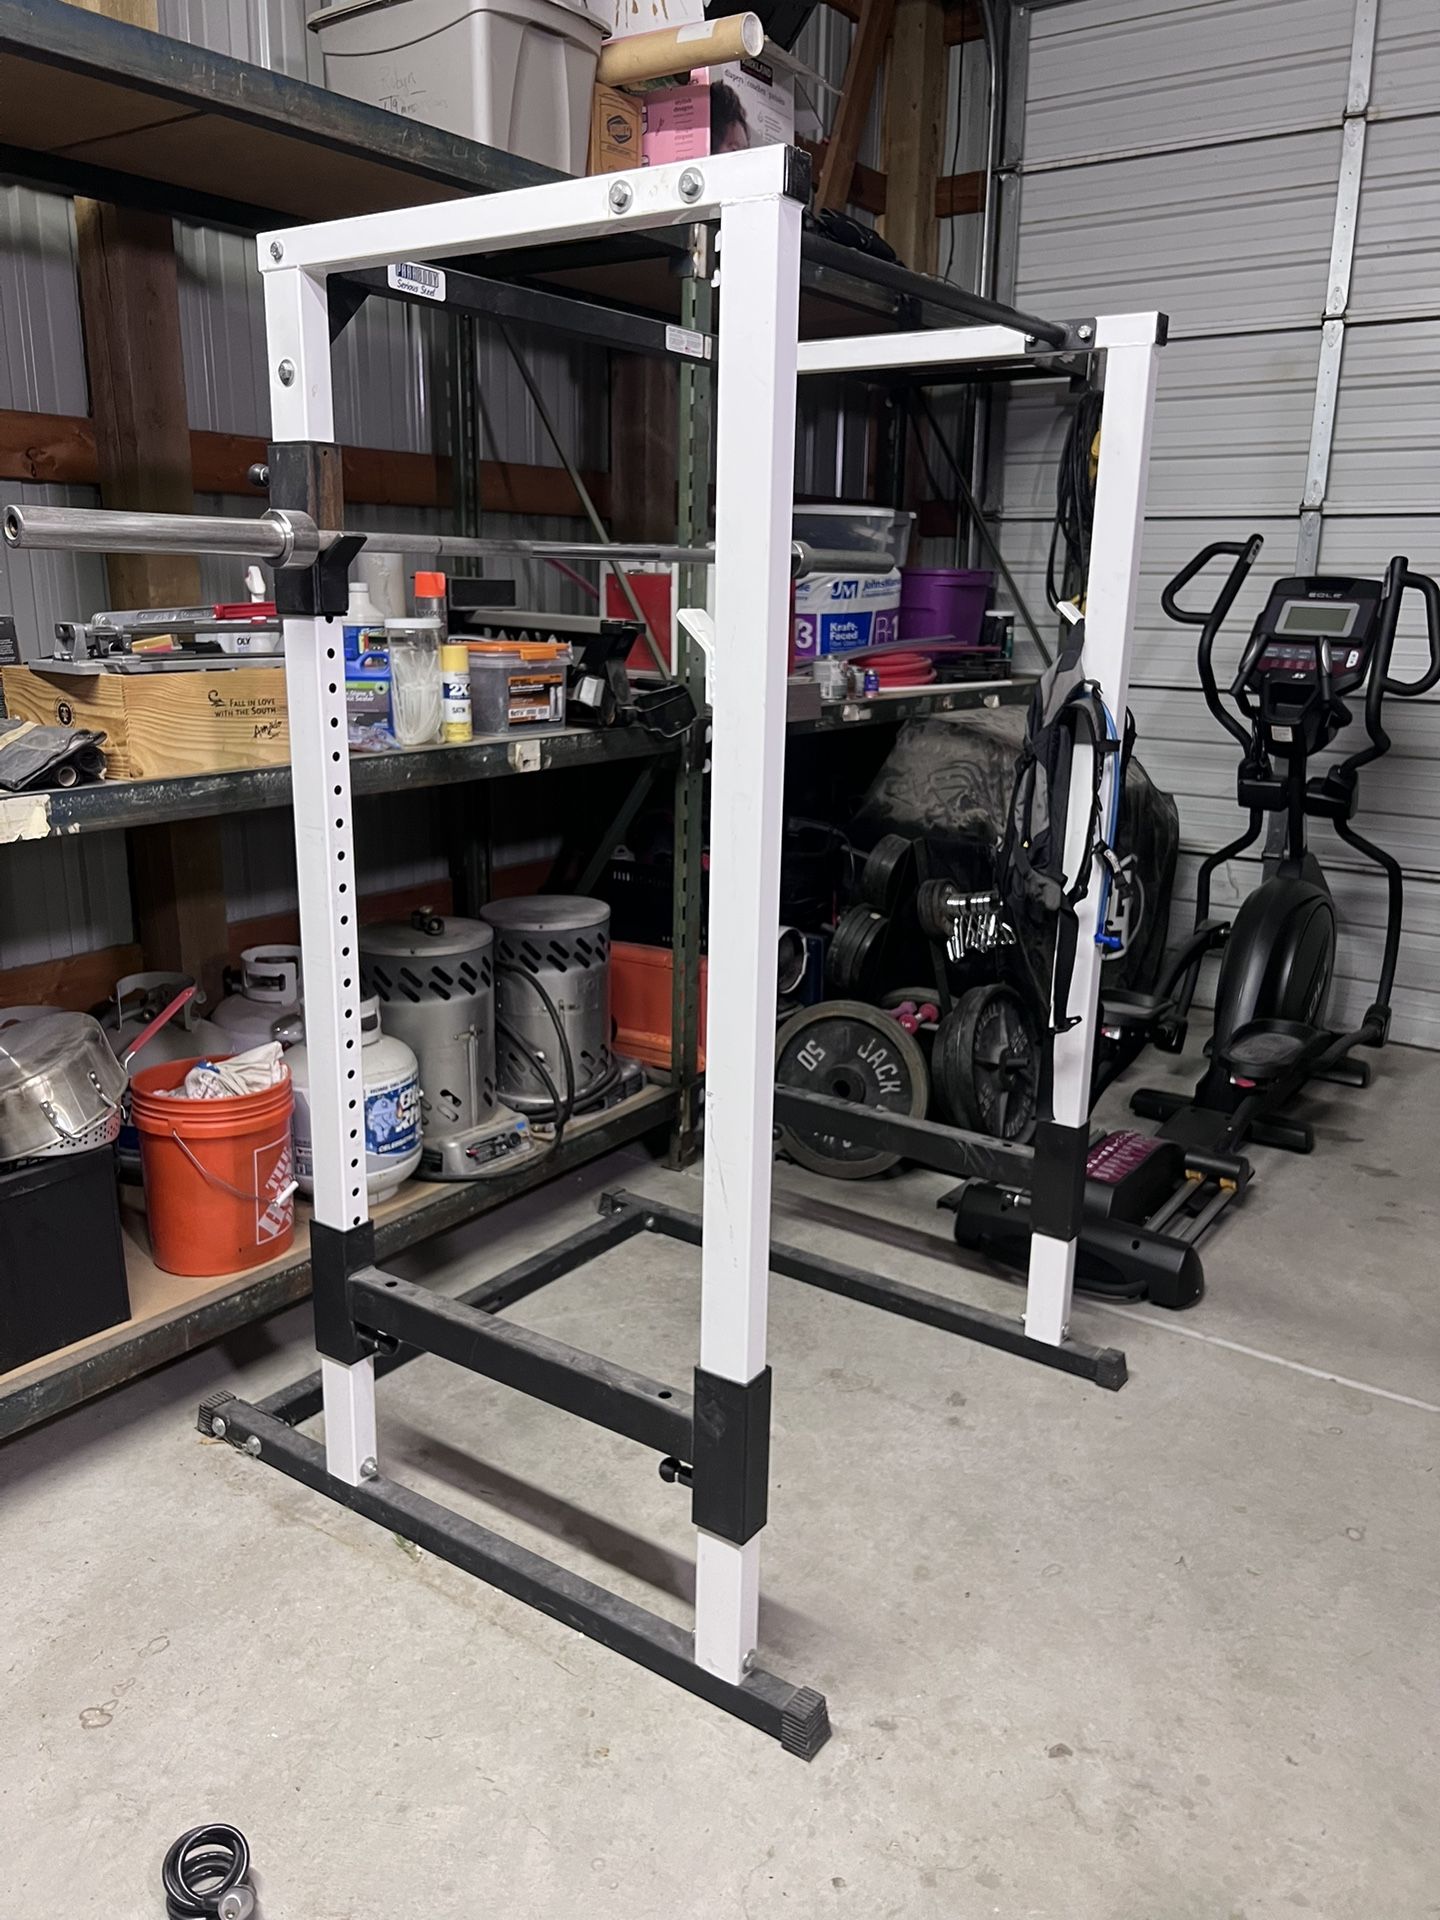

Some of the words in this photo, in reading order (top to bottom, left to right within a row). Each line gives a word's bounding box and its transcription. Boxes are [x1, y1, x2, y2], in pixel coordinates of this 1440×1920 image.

[832, 581, 859, 599] JM
[830, 630, 859, 641] Faced
[448, 683, 471, 697] 2X
[230, 699, 246, 707] FALL
[248, 699, 256, 707] IN
[258, 698, 275, 706] LOVE
[214, 709, 234, 717] WITH
[236, 708, 249, 716] THE
[251, 706, 276, 715] SOUTH
